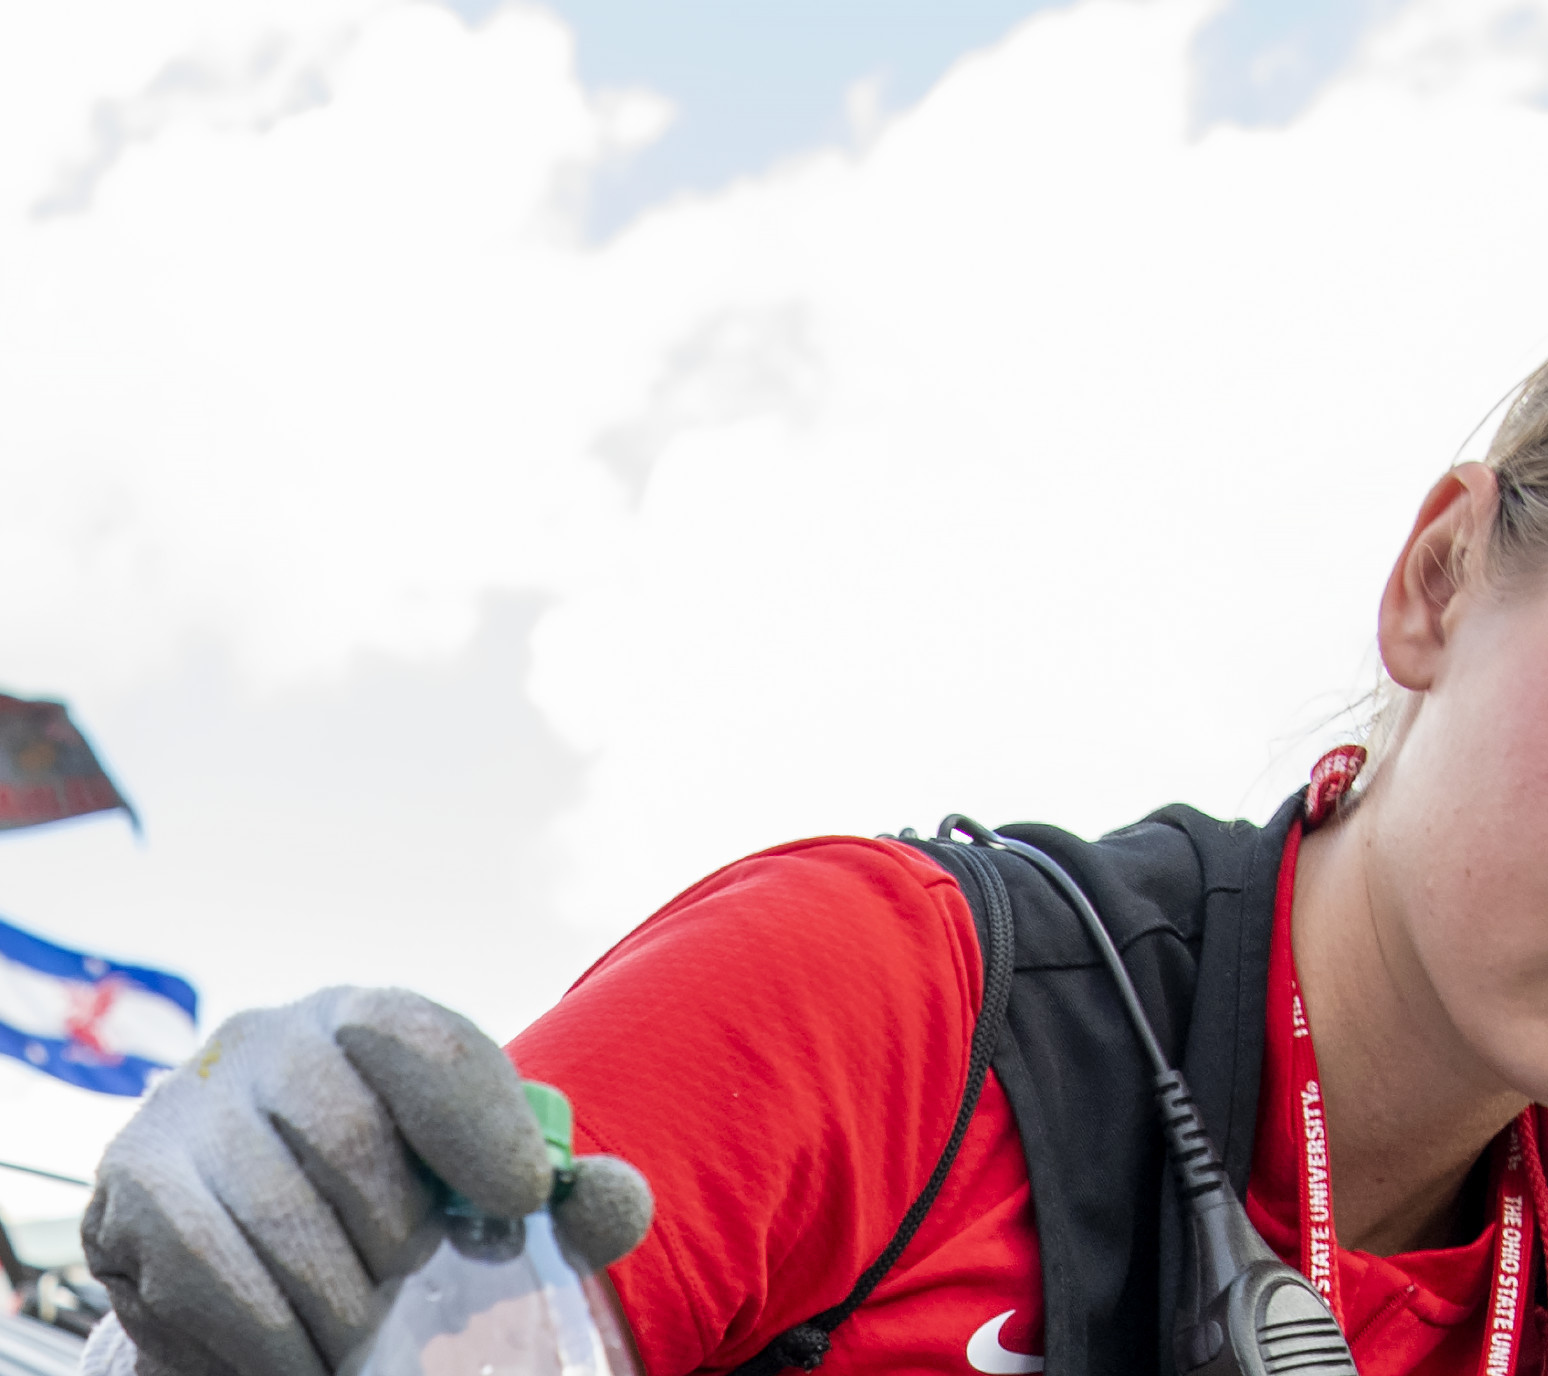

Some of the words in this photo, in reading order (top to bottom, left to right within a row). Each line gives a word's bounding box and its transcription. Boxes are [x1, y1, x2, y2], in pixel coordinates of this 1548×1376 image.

[1503, 1195, 1524, 1227] THE
[1501, 1228, 1523, 1276] OHIO
[1492, 1274, 1519, 1332] STATE
